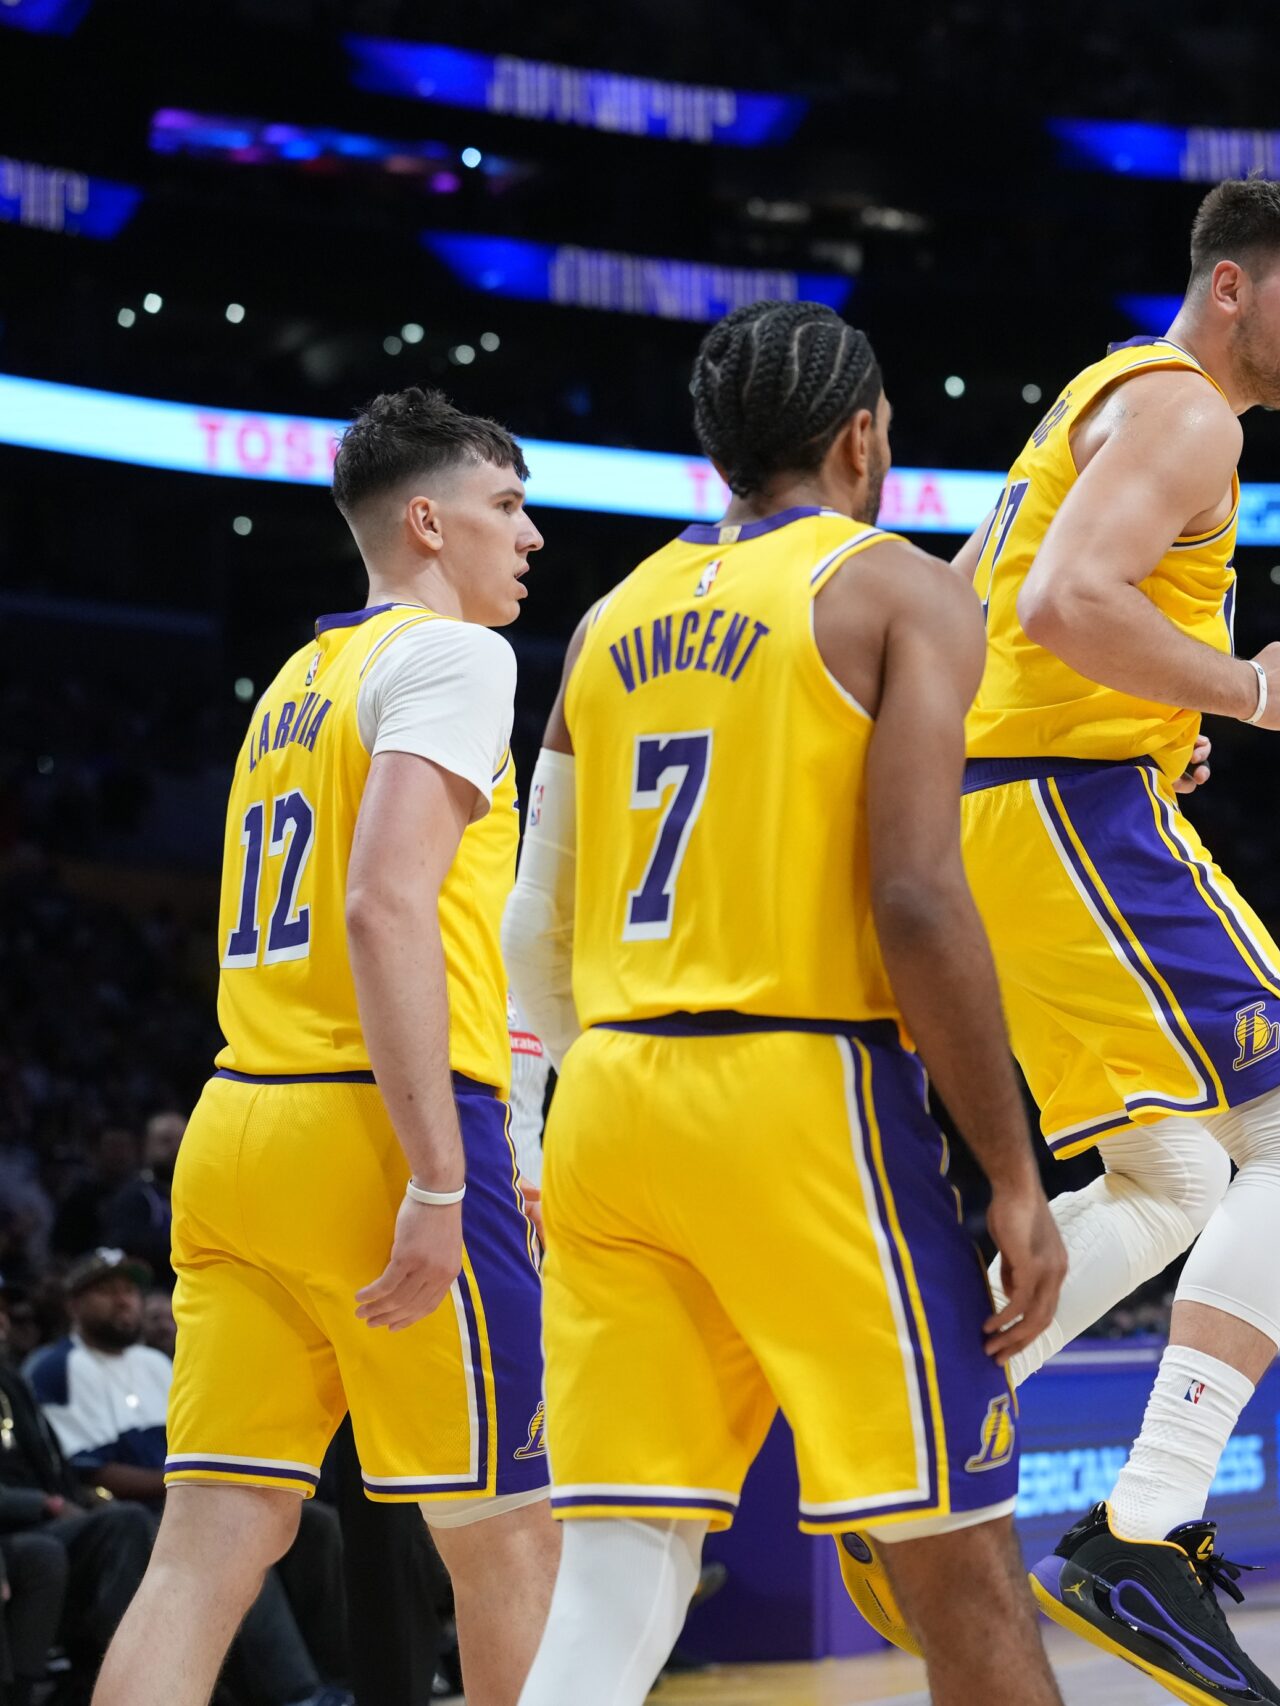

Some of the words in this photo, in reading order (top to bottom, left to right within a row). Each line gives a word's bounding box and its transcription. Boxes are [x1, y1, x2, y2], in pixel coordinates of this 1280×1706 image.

[608, 609, 771, 694] VINCENT
[220, 788, 315, 969] 12
[622, 728, 714, 942] 7
